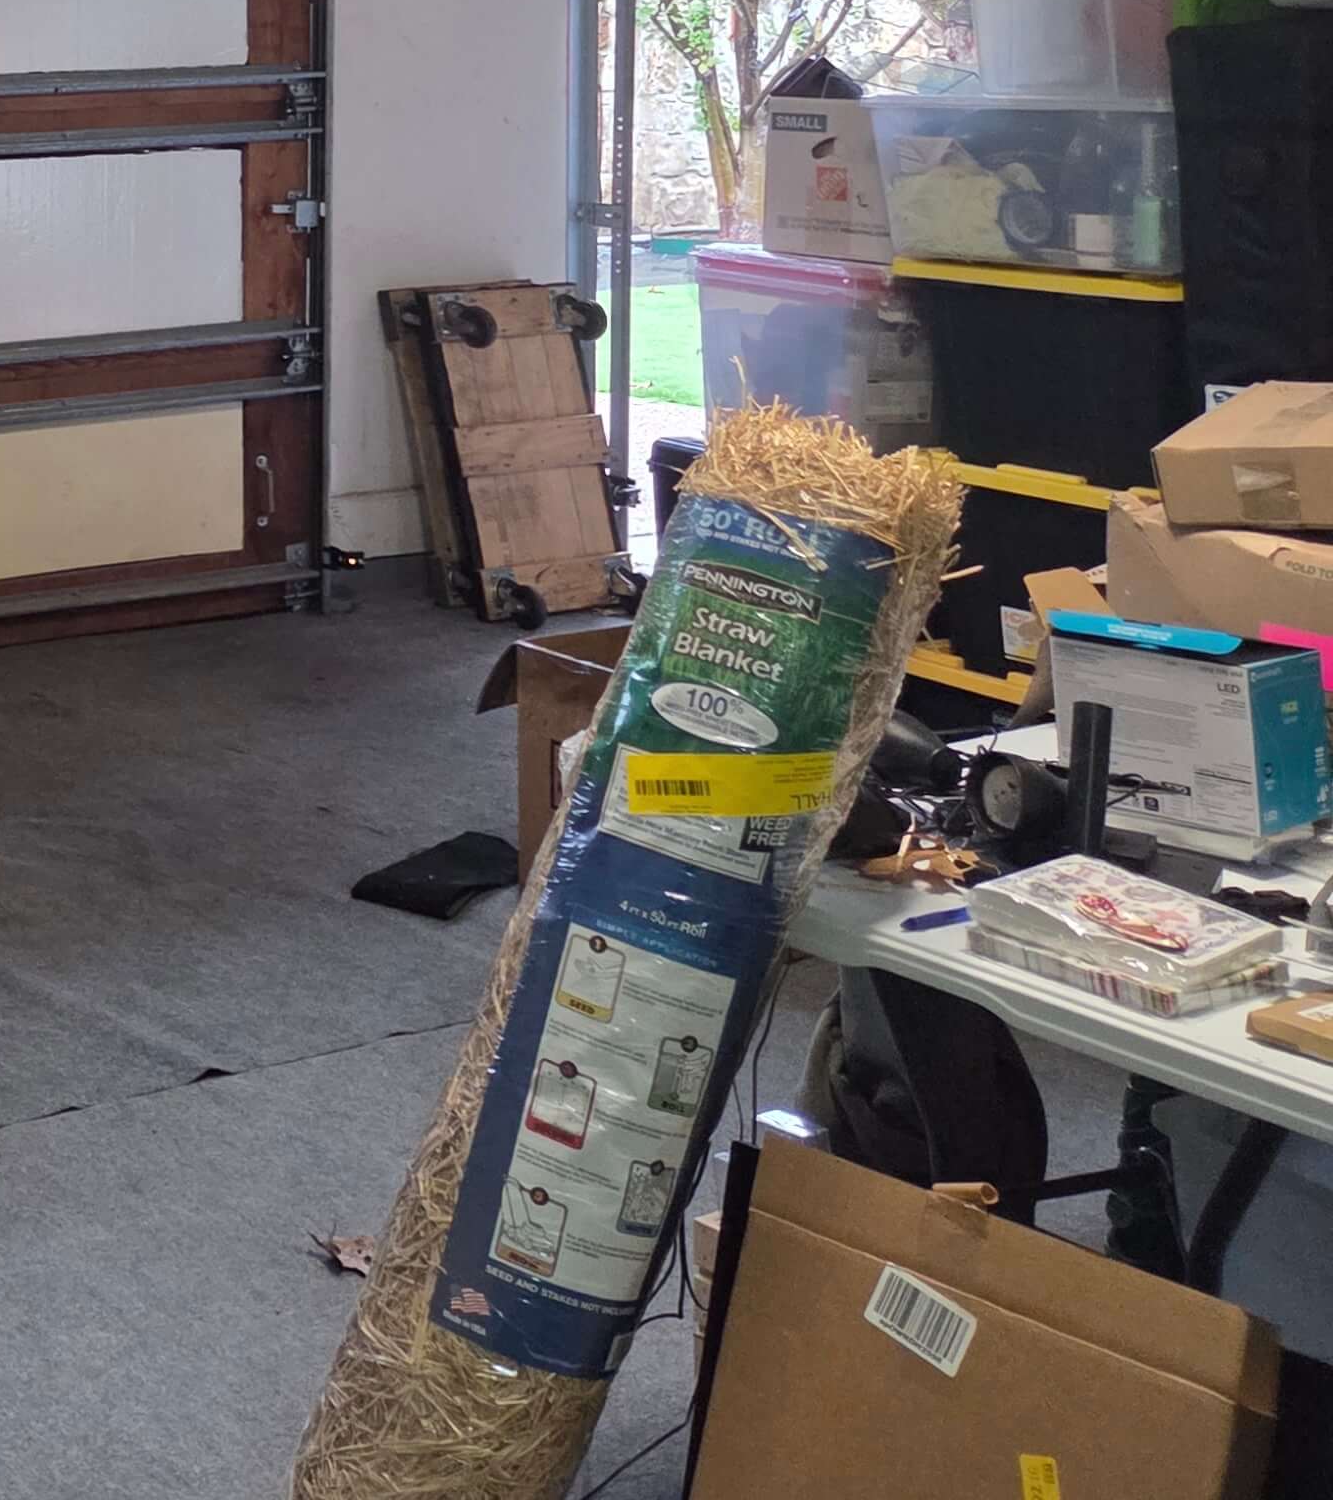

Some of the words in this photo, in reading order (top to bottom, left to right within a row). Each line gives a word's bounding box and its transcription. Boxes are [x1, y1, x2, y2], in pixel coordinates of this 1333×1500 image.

[775, 115, 822, 130] SMALL
[683, 563, 814, 612] PENNINGTON
[692, 606, 776, 649] Straw
[673, 632, 785, 683] Blanket
[1217, 682, 1241, 695] LED
[748, 816, 791, 831] WEED
[747, 831, 787, 847] FREE
[485, 1263, 514, 1284] SEED
[515, 1277, 538, 1294] AND
